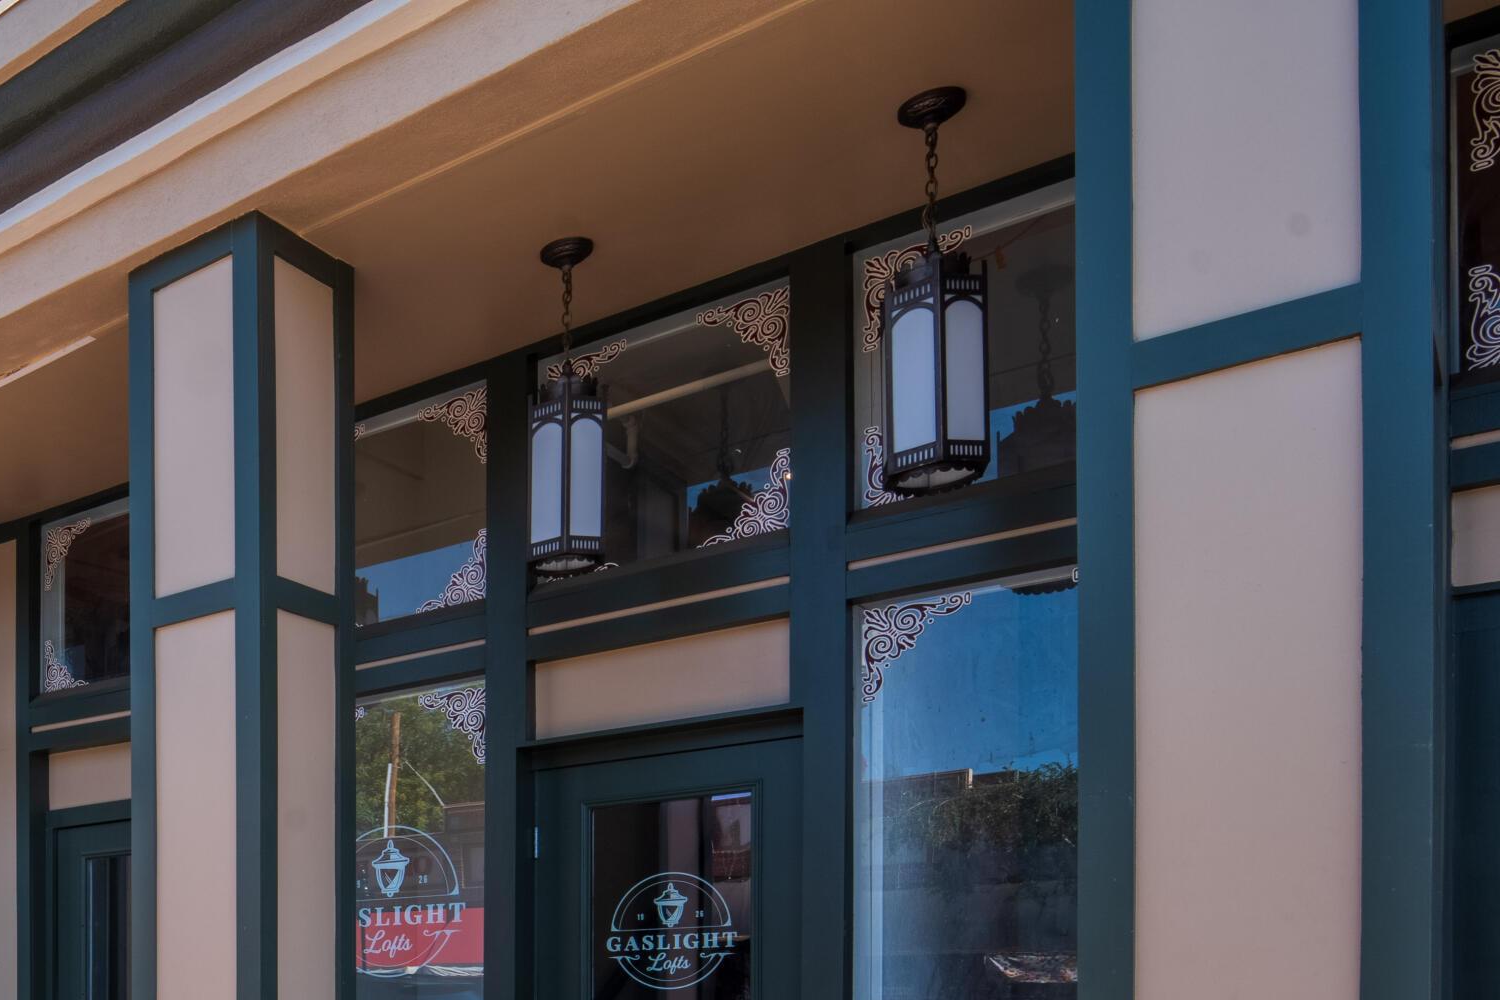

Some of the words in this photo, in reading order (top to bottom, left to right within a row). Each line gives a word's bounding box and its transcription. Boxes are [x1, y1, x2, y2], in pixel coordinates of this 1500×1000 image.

[358, 902, 466, 928] SLIGHT
[363, 929, 413, 958] Lofts
[606, 931, 738, 952] GASLIGHT
[646, 952, 692, 974] Lofts
